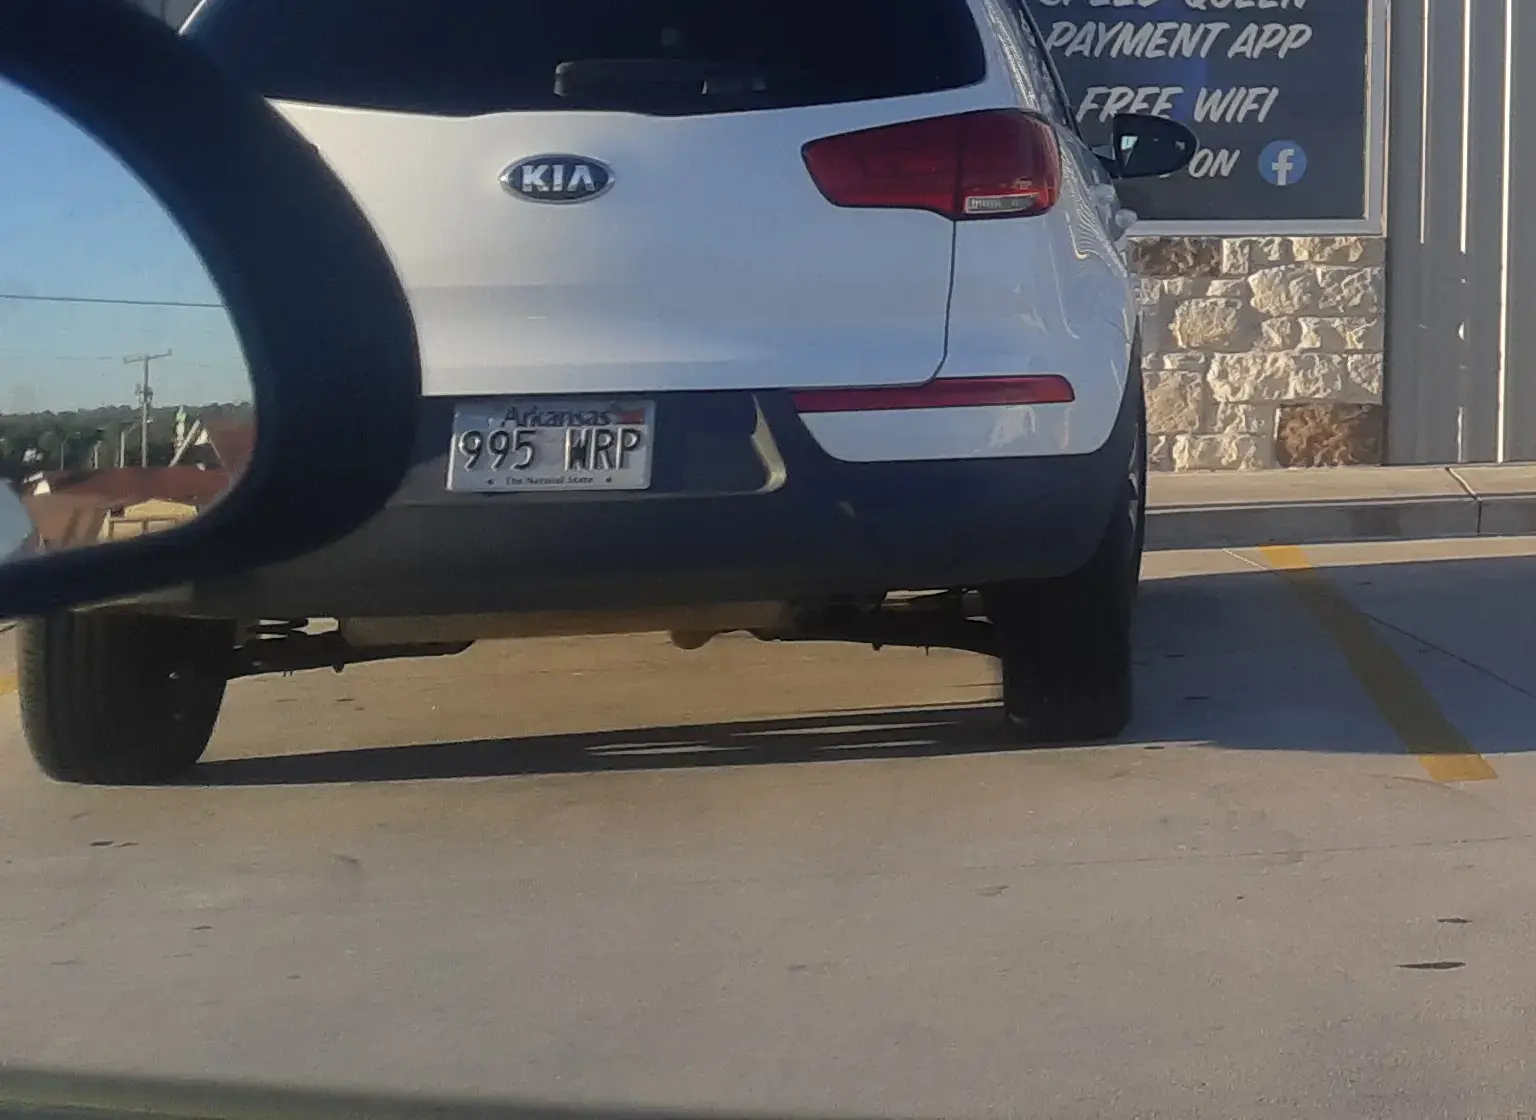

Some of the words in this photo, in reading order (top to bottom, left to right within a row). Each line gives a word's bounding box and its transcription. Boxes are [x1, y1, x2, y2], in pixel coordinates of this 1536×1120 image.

[1045, 20, 1231, 59] PAYMENT
[1227, 23, 1314, 60] APP
[1076, 86, 1184, 124] FREE
[1193, 86, 1280, 124] WIFI
[522, 164, 596, 192] KIA
[500, 405, 611, 427] Arkansas
[458, 429, 536, 472] 995
[563, 428, 642, 472] WRP
